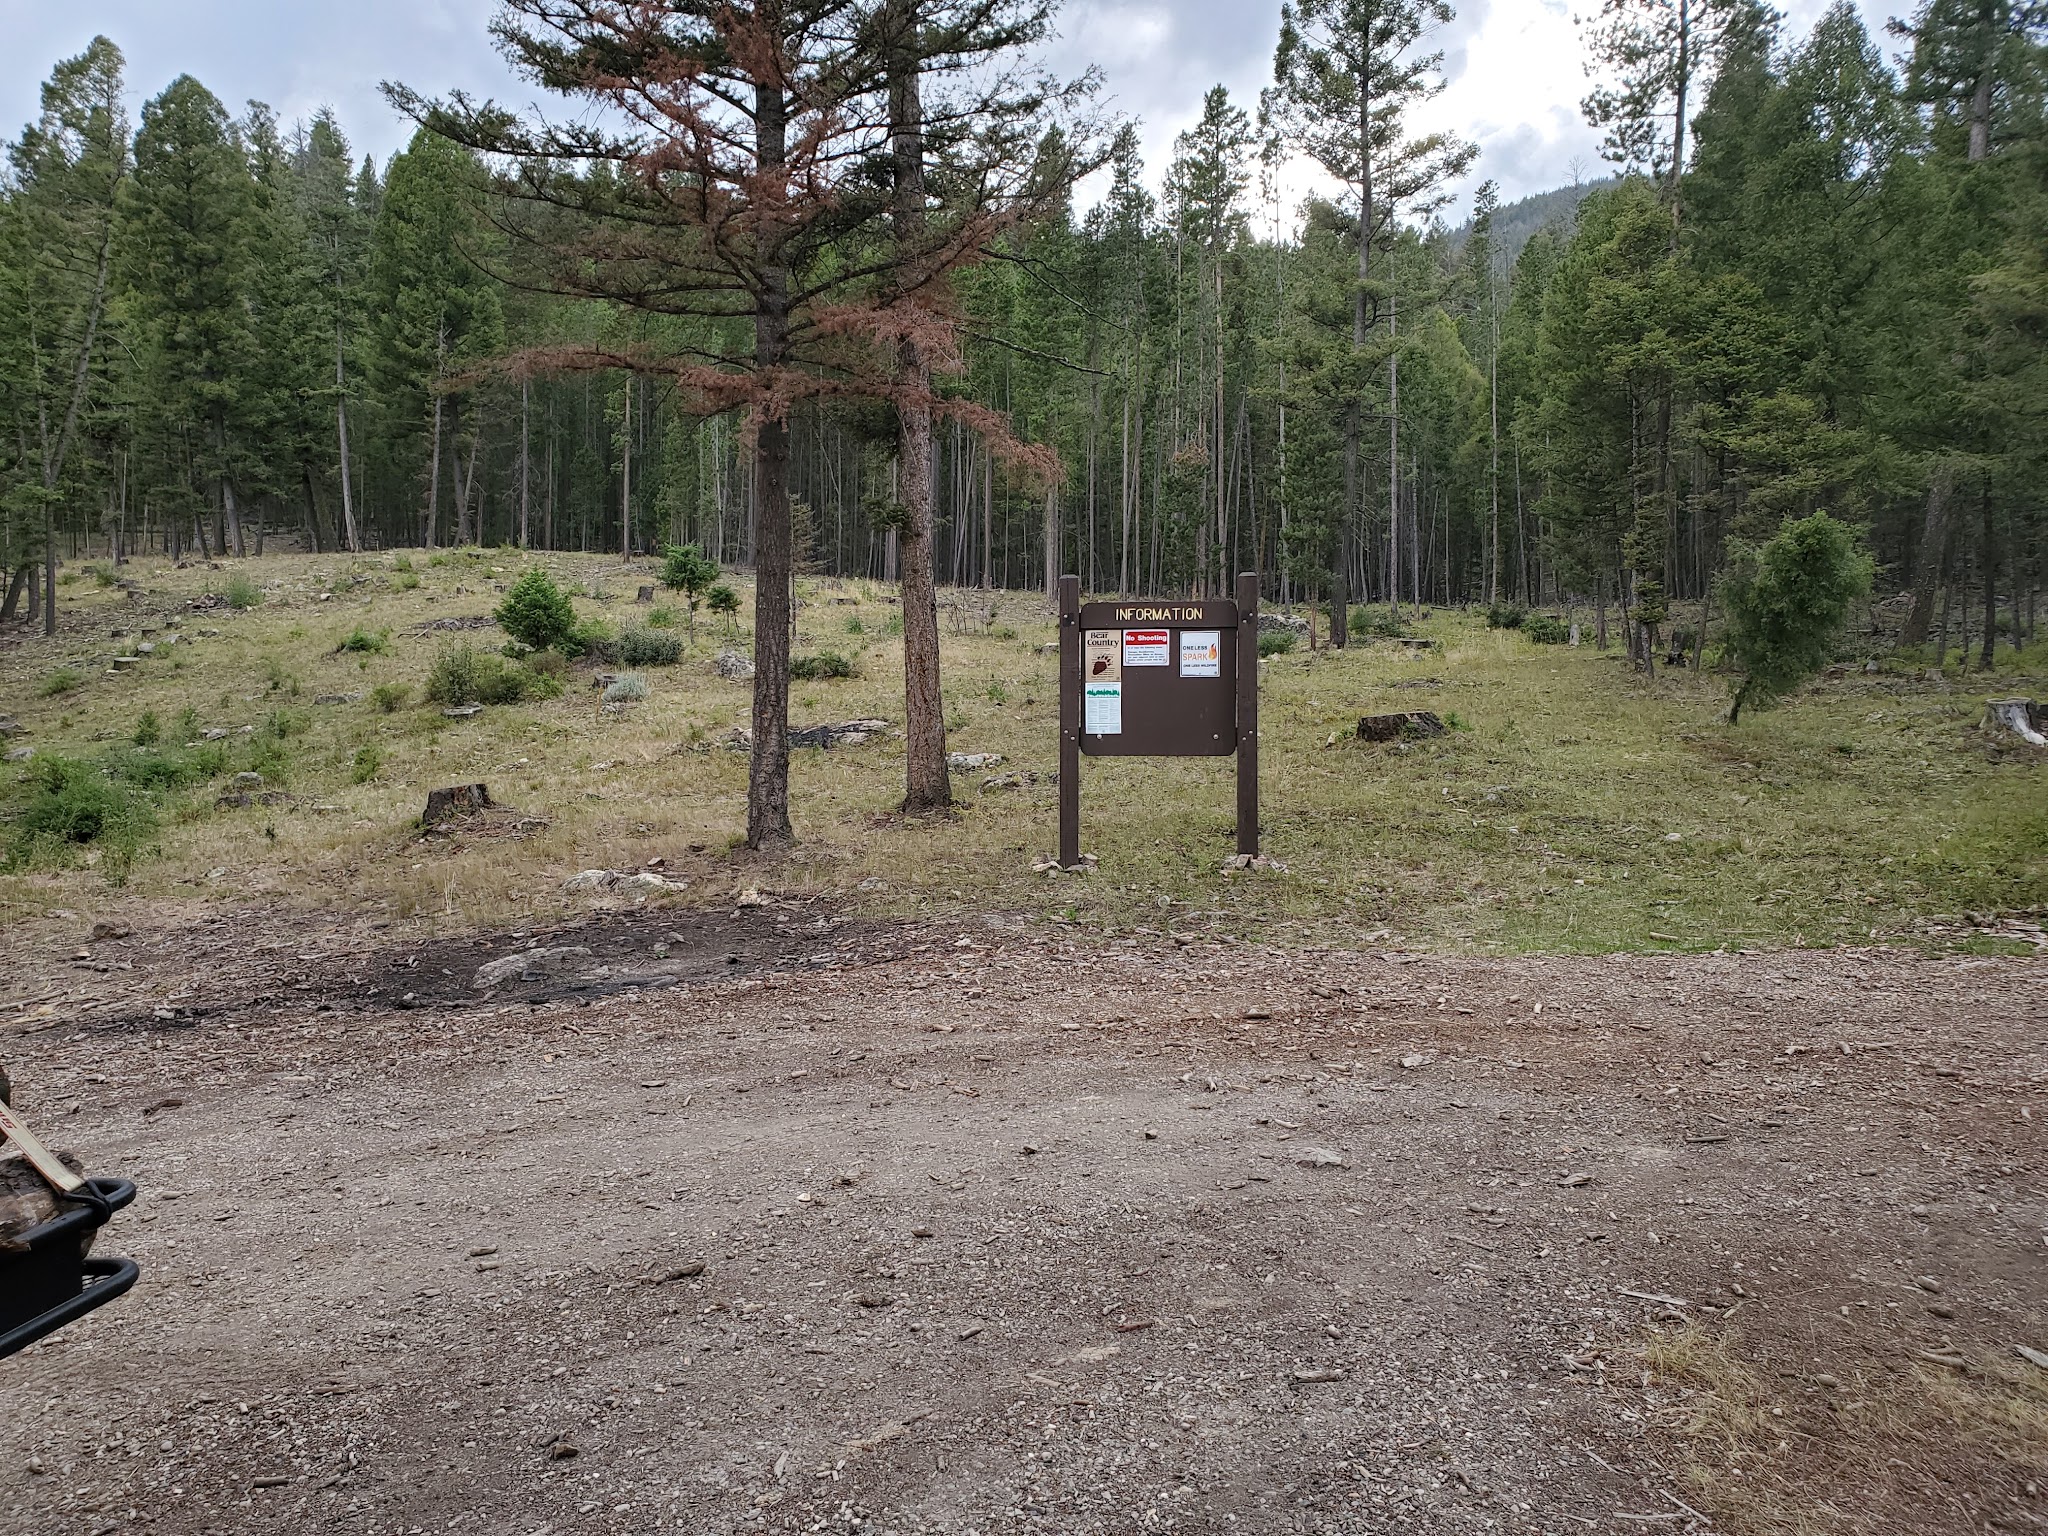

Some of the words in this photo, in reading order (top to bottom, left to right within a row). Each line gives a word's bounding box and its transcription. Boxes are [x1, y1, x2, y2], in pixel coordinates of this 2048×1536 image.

[1115, 607, 1203, 621] INFORMATION
[1137, 634, 1167, 642] Shooting
[1087, 639, 1119, 648] Country
